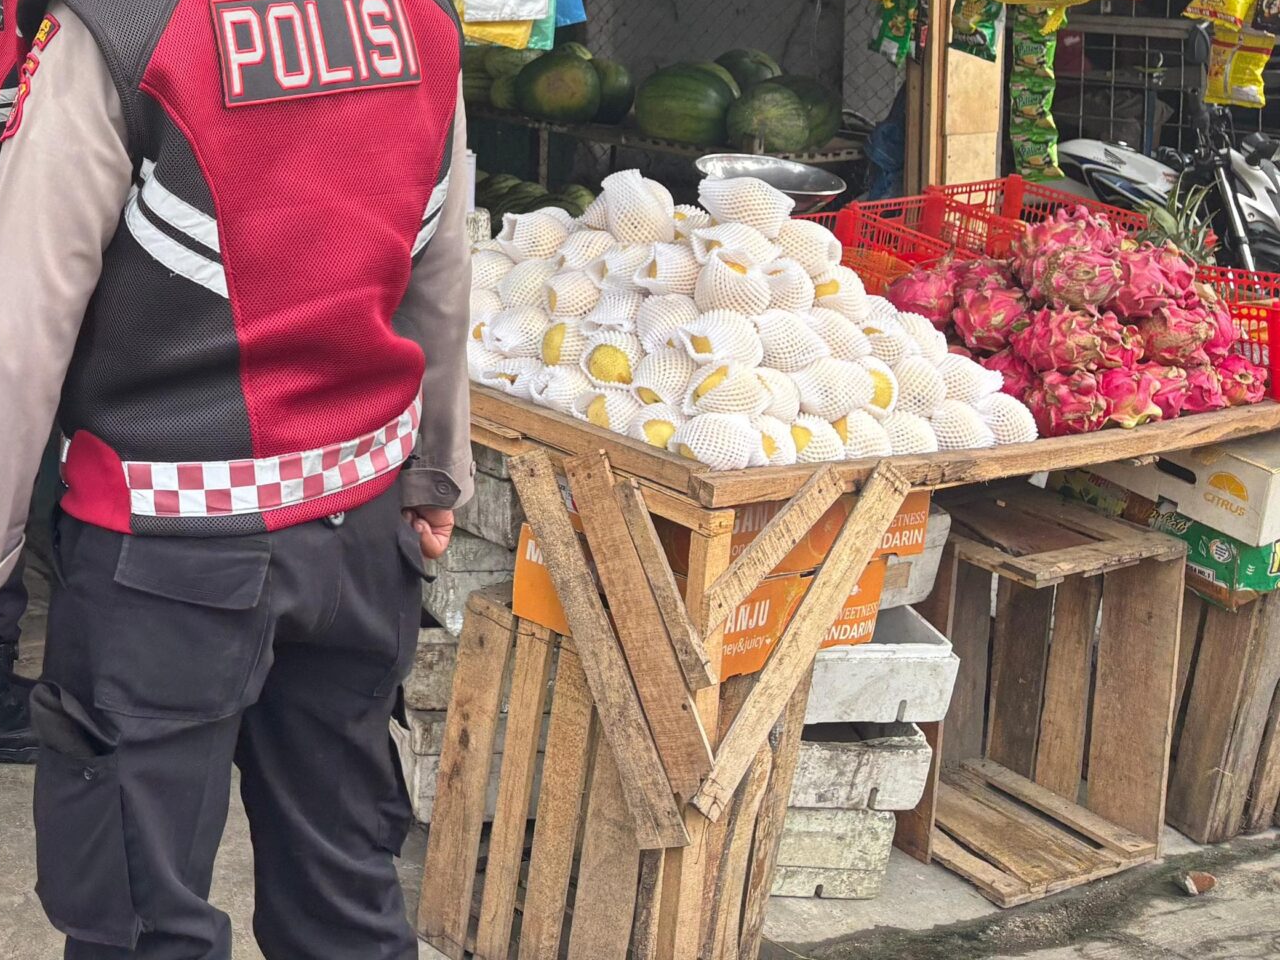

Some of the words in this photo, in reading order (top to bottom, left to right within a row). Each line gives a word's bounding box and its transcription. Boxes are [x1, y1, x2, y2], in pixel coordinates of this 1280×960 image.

[1203, 491, 1247, 517] CITRUS
[878, 528, 925, 551] DARIN
[824, 618, 875, 641] NDARIN
